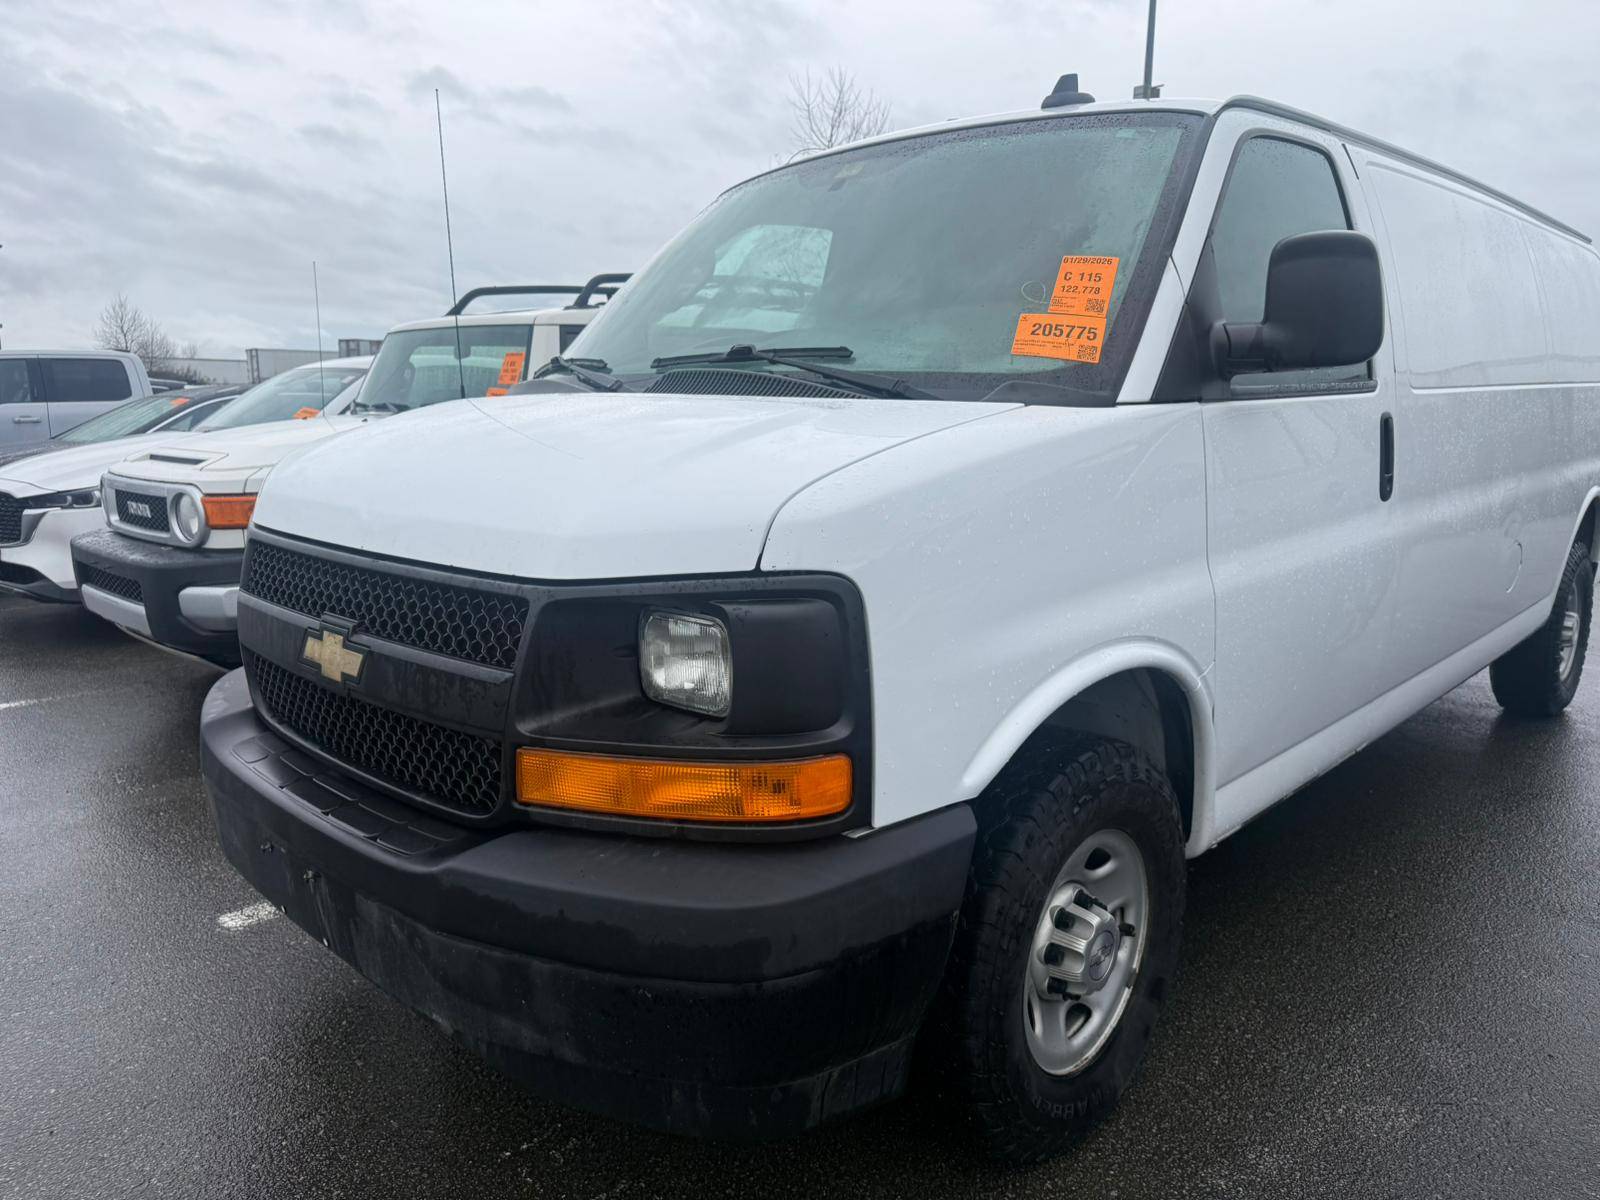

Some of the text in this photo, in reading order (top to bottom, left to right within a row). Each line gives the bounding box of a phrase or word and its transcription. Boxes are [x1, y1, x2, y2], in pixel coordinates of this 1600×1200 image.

[1063, 256, 1113, 265] 01/29/2026
[1064, 271, 1103, 282] C 115
[1061, 284, 1101, 295] 122,778
[1030, 323, 1098, 341] 205775
